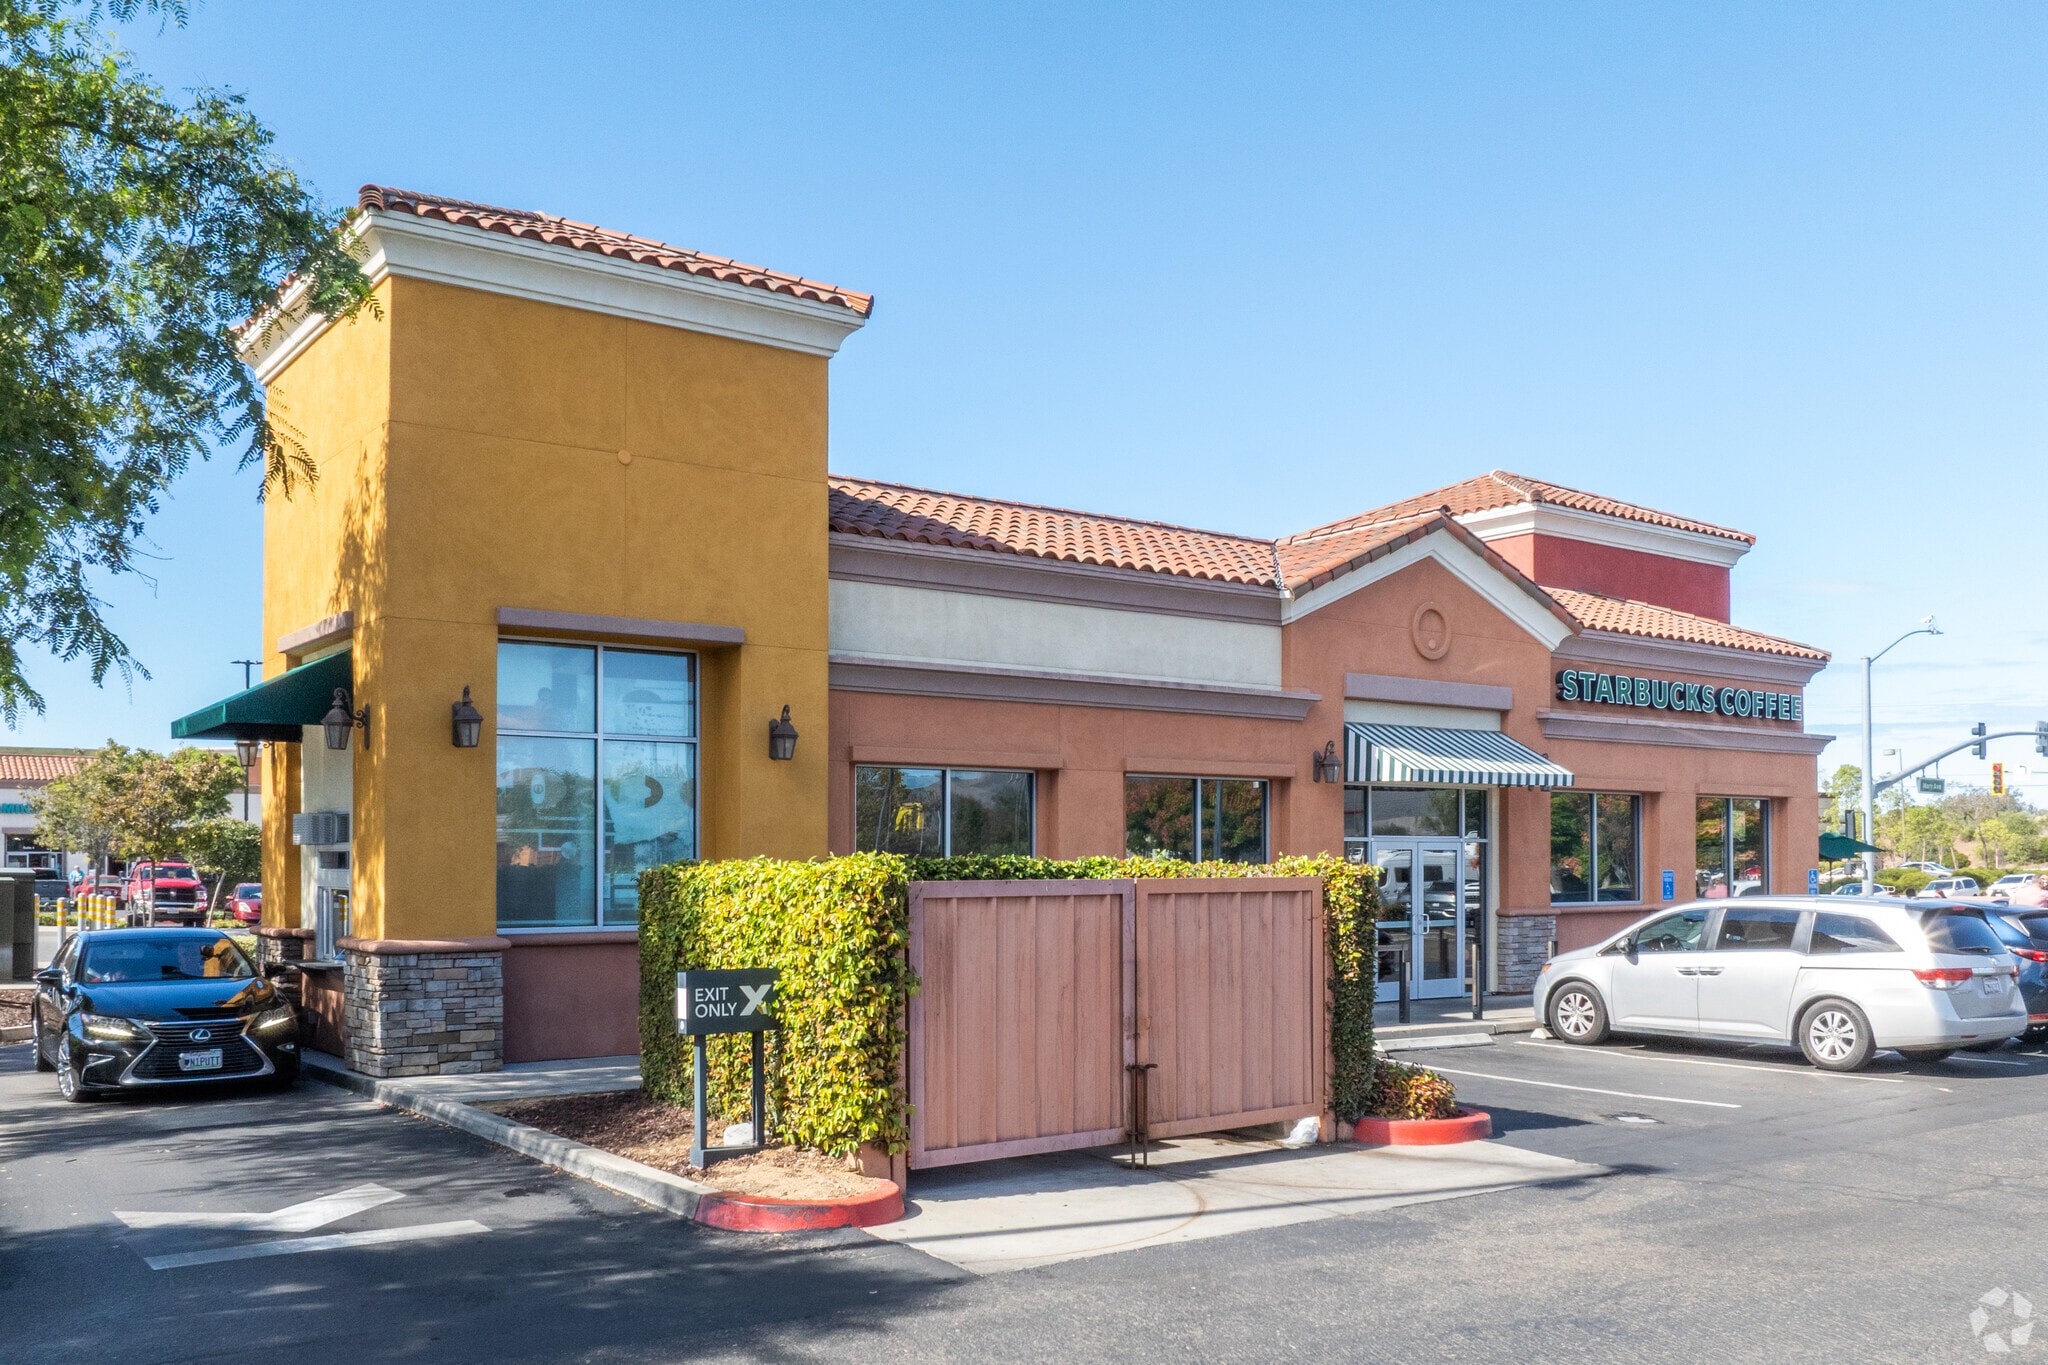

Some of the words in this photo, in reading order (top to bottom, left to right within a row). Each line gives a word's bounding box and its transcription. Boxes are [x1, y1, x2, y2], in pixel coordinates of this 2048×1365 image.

[1562, 669, 1716, 713] STARBUCKS
[1720, 687, 1802, 720] COFFEE
[695, 987, 729, 1002] EXIT
[695, 1002, 737, 1018] ONLY
